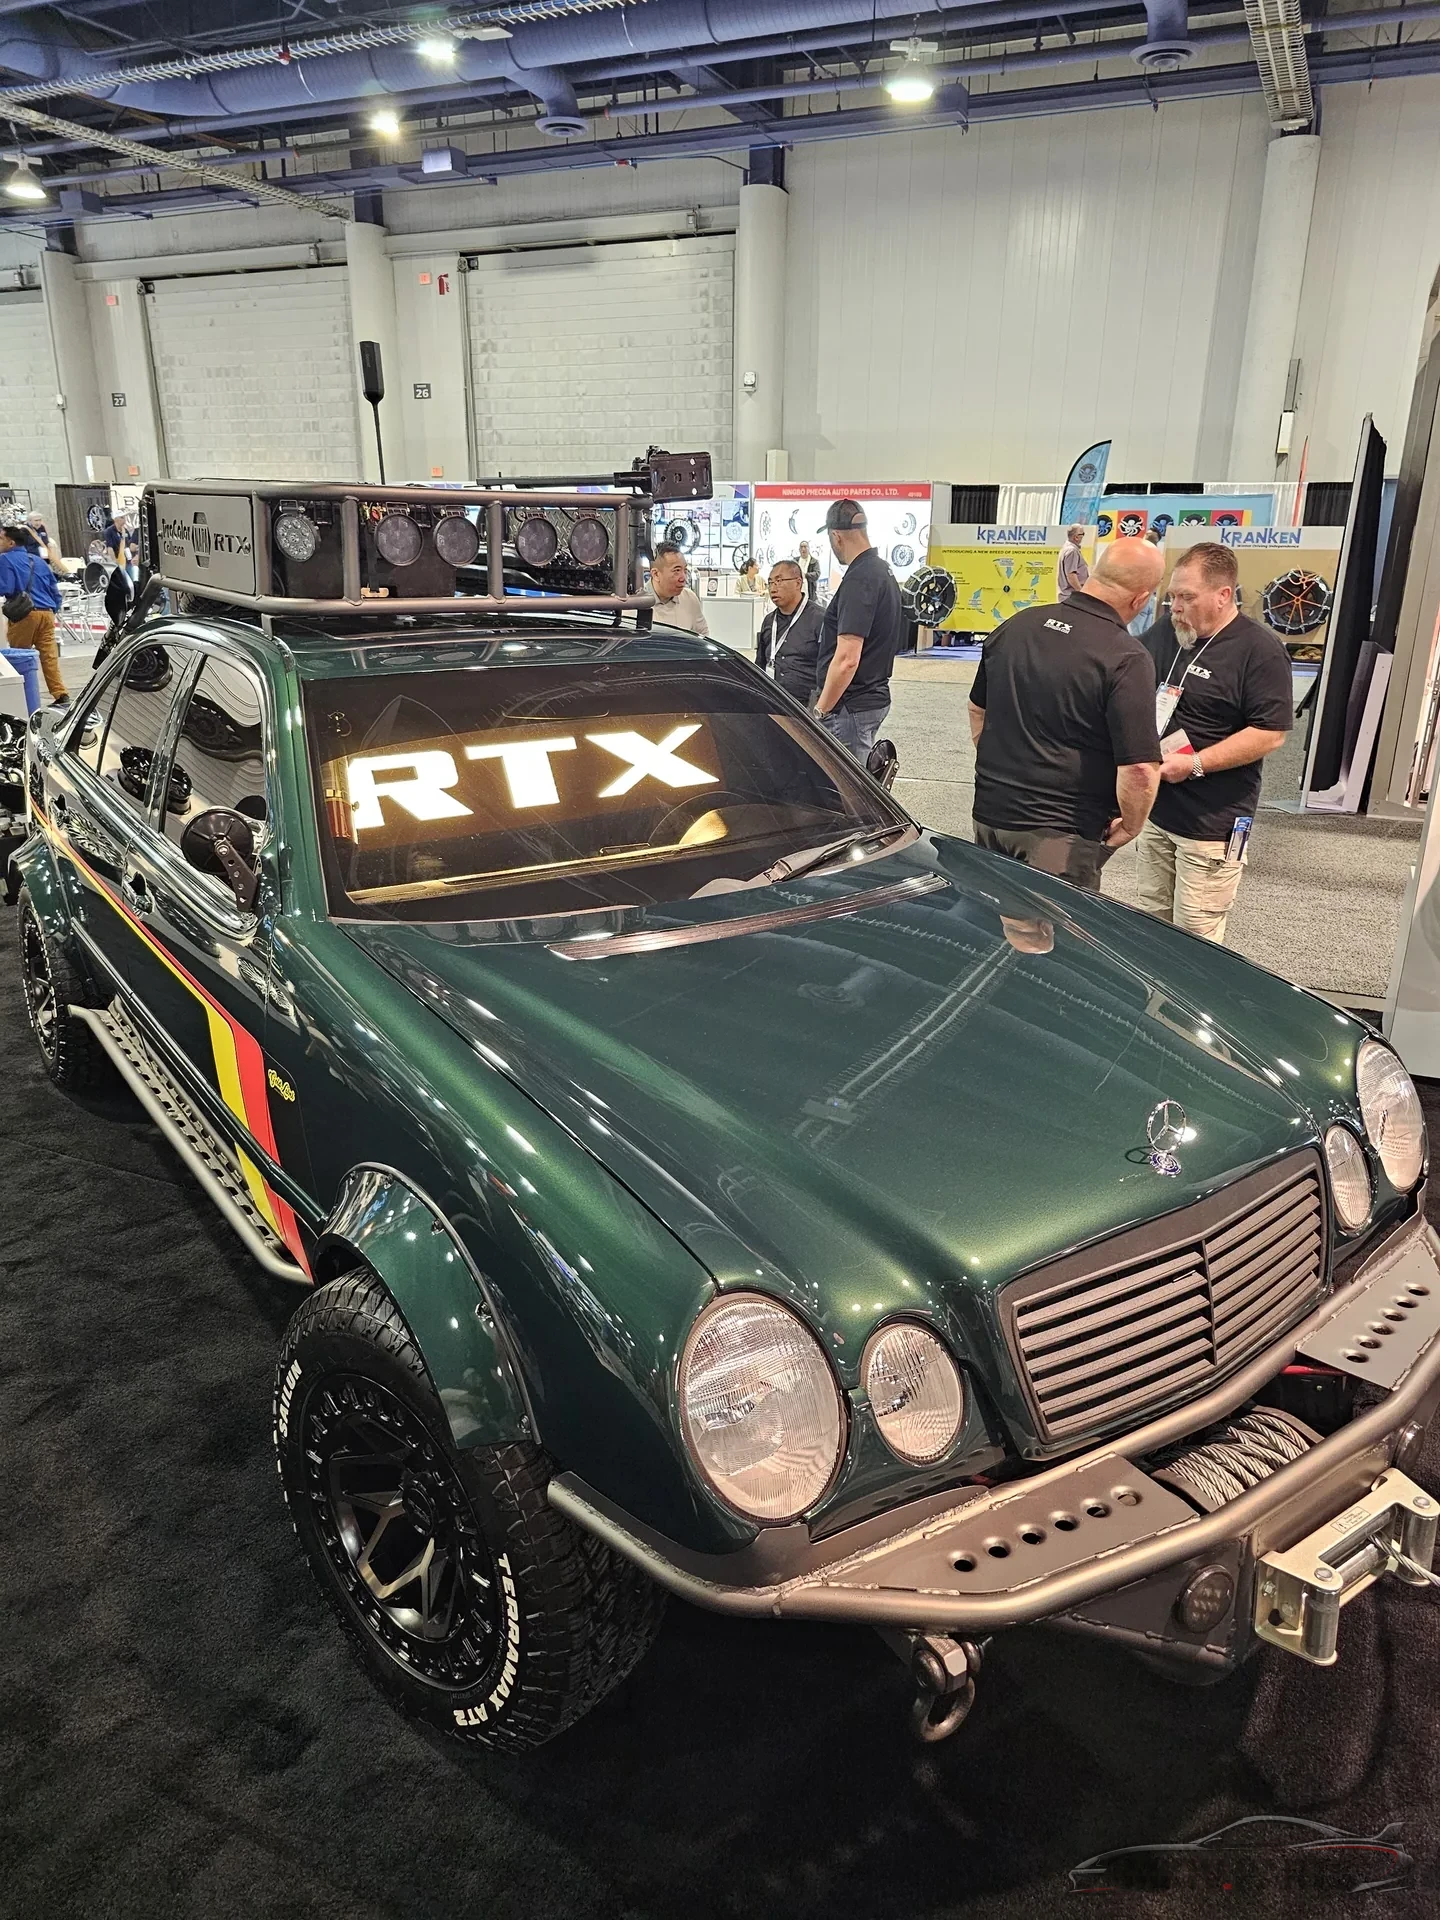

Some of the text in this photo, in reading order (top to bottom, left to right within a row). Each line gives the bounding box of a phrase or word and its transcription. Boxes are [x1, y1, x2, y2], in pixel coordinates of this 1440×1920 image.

[114, 398, 124, 406] 27
[416, 389, 429, 398] 26
[782, 488, 805, 496] NINGBO
[806, 488, 832, 496] PHECDA
[832, 488, 850, 496] AUTO
[850, 488, 870, 496] PARTS
[885, 488, 899, 496] LTD.
[213, 532, 248, 554] RTX
[1045, 618, 1073, 631] RTX
[347, 723, 720, 829] RTX
[279, 1359, 302, 1438] SAILUN
[489, 1552, 520, 1711] TERRAMAX
[453, 1703, 489, 1727] AT2
